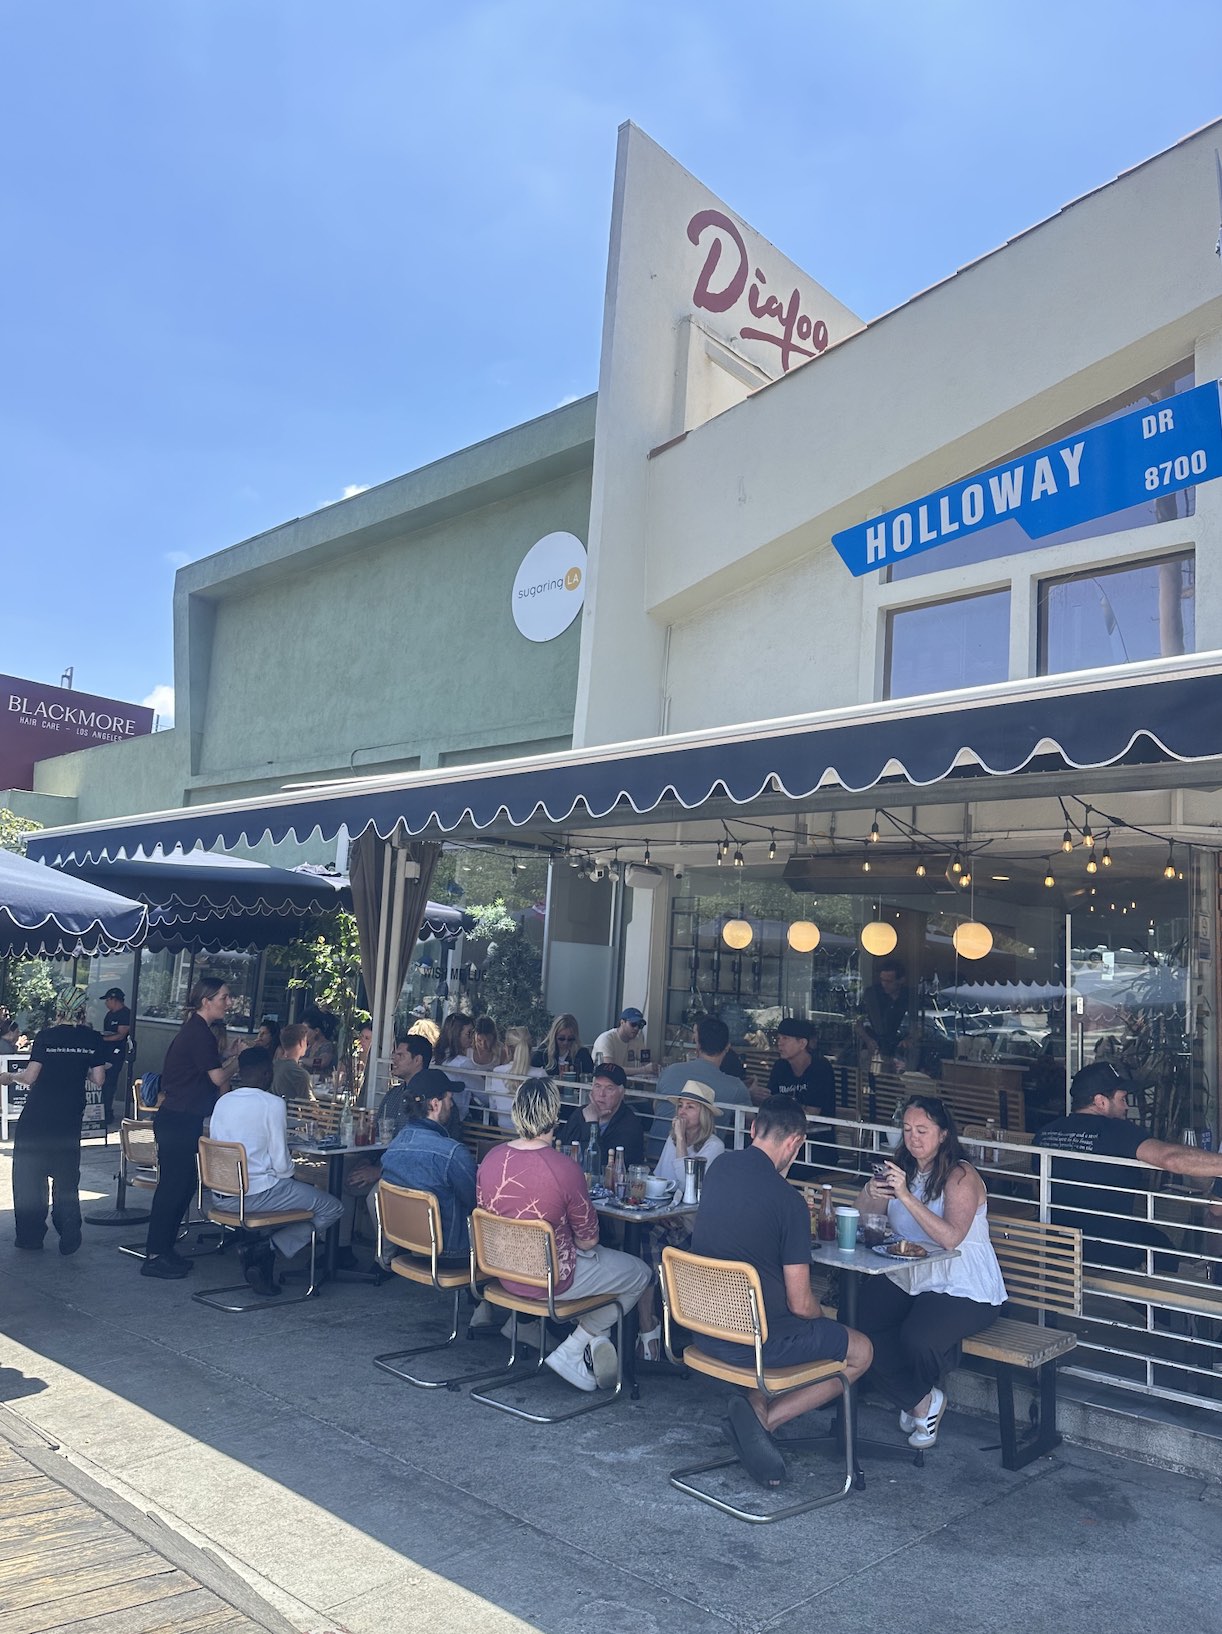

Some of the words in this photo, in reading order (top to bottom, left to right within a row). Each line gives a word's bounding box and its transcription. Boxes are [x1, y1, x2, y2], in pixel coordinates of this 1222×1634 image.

[1144, 449, 1208, 492] 8700
[866, 441, 1086, 565] HOLLOWAY
[1142, 408, 1175, 440] DR
[518, 577, 564, 599] sugaring
[567, 573, 579, 585] LA
[8, 695, 137, 736] BLACKMORE
[19, 716, 37, 727] HAIR
[41, 720, 61, 731] CARE
[76, 727, 89, 737] LOS
[92, 730, 123, 743] ANGELES
[468, 968, 488, 982] LUC
[85, 1091, 103, 1104] RTY
